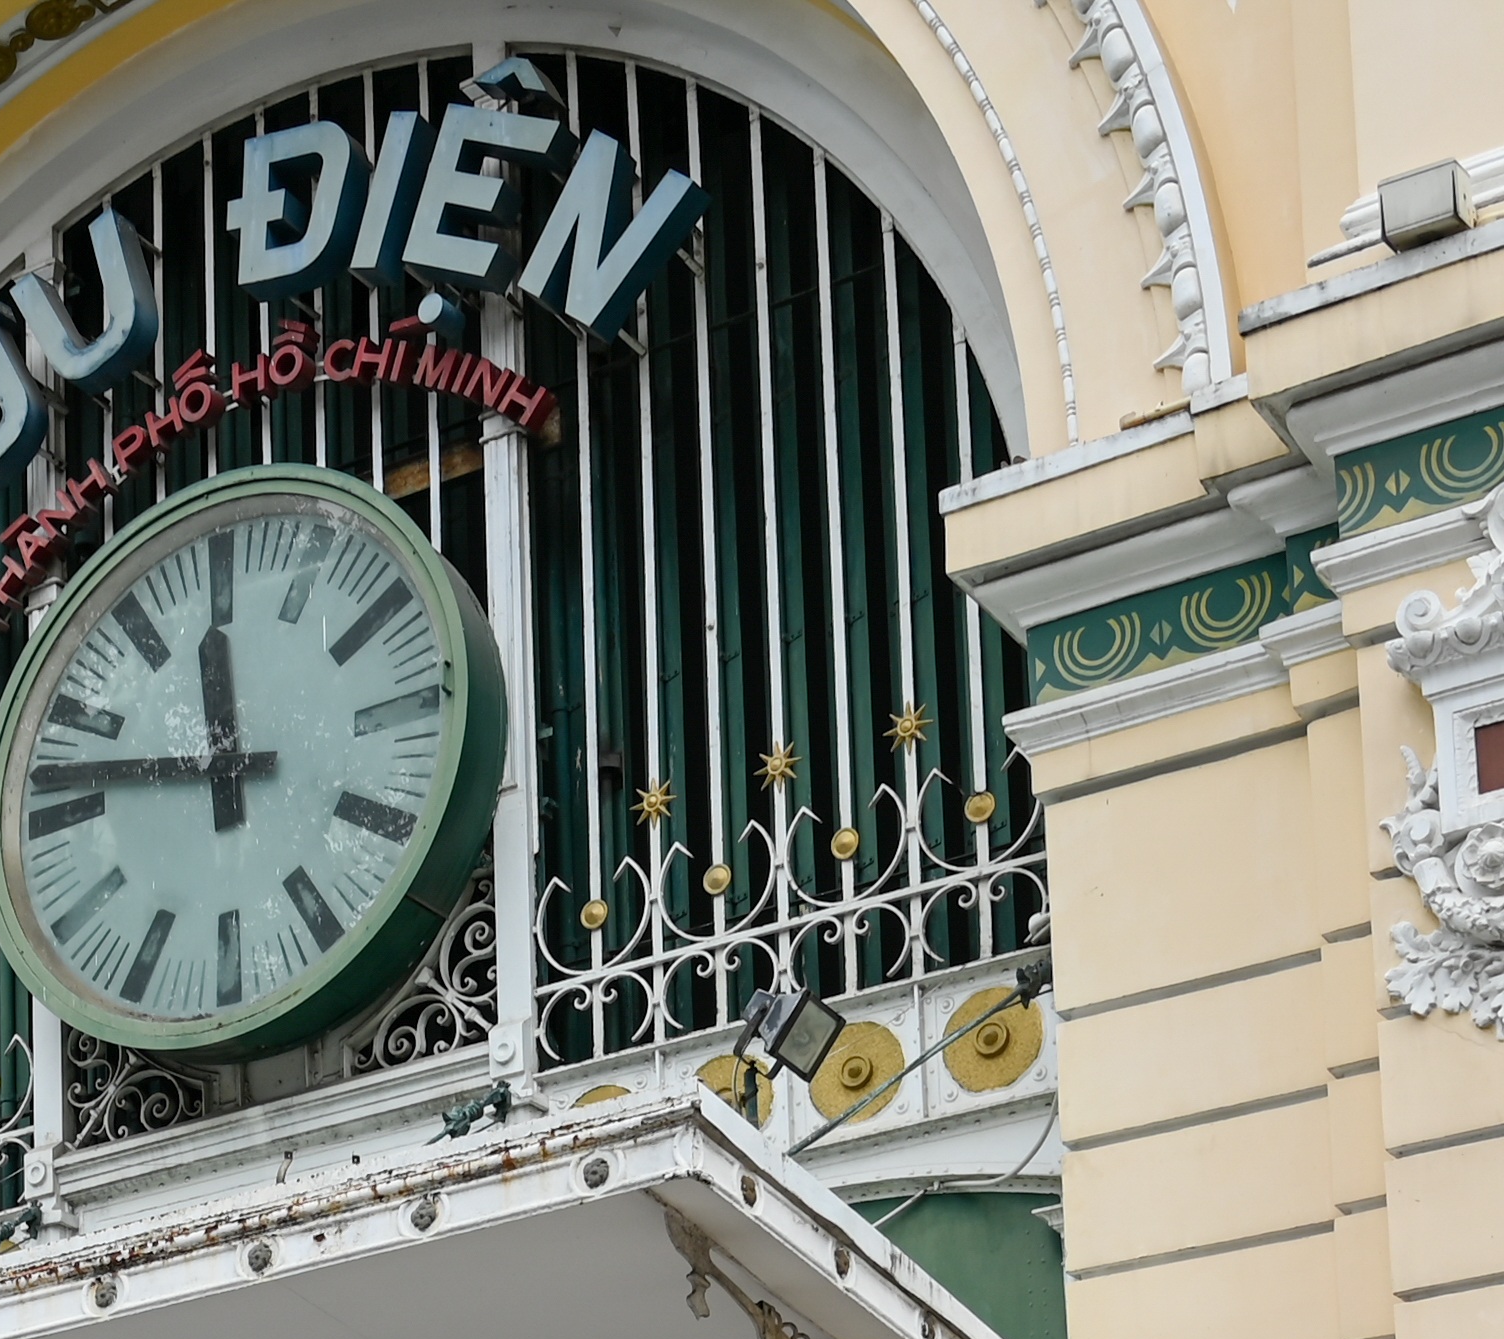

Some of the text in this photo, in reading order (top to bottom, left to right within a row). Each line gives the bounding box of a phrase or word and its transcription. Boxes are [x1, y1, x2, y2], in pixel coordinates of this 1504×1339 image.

[226, 56, 710, 344] ĐIỆN
[112, 348, 225, 473] PHỐ
[232, 318, 320, 400] HỒ
[322, 315, 424, 381] CHÍ
[412, 343, 560, 432] MINH
